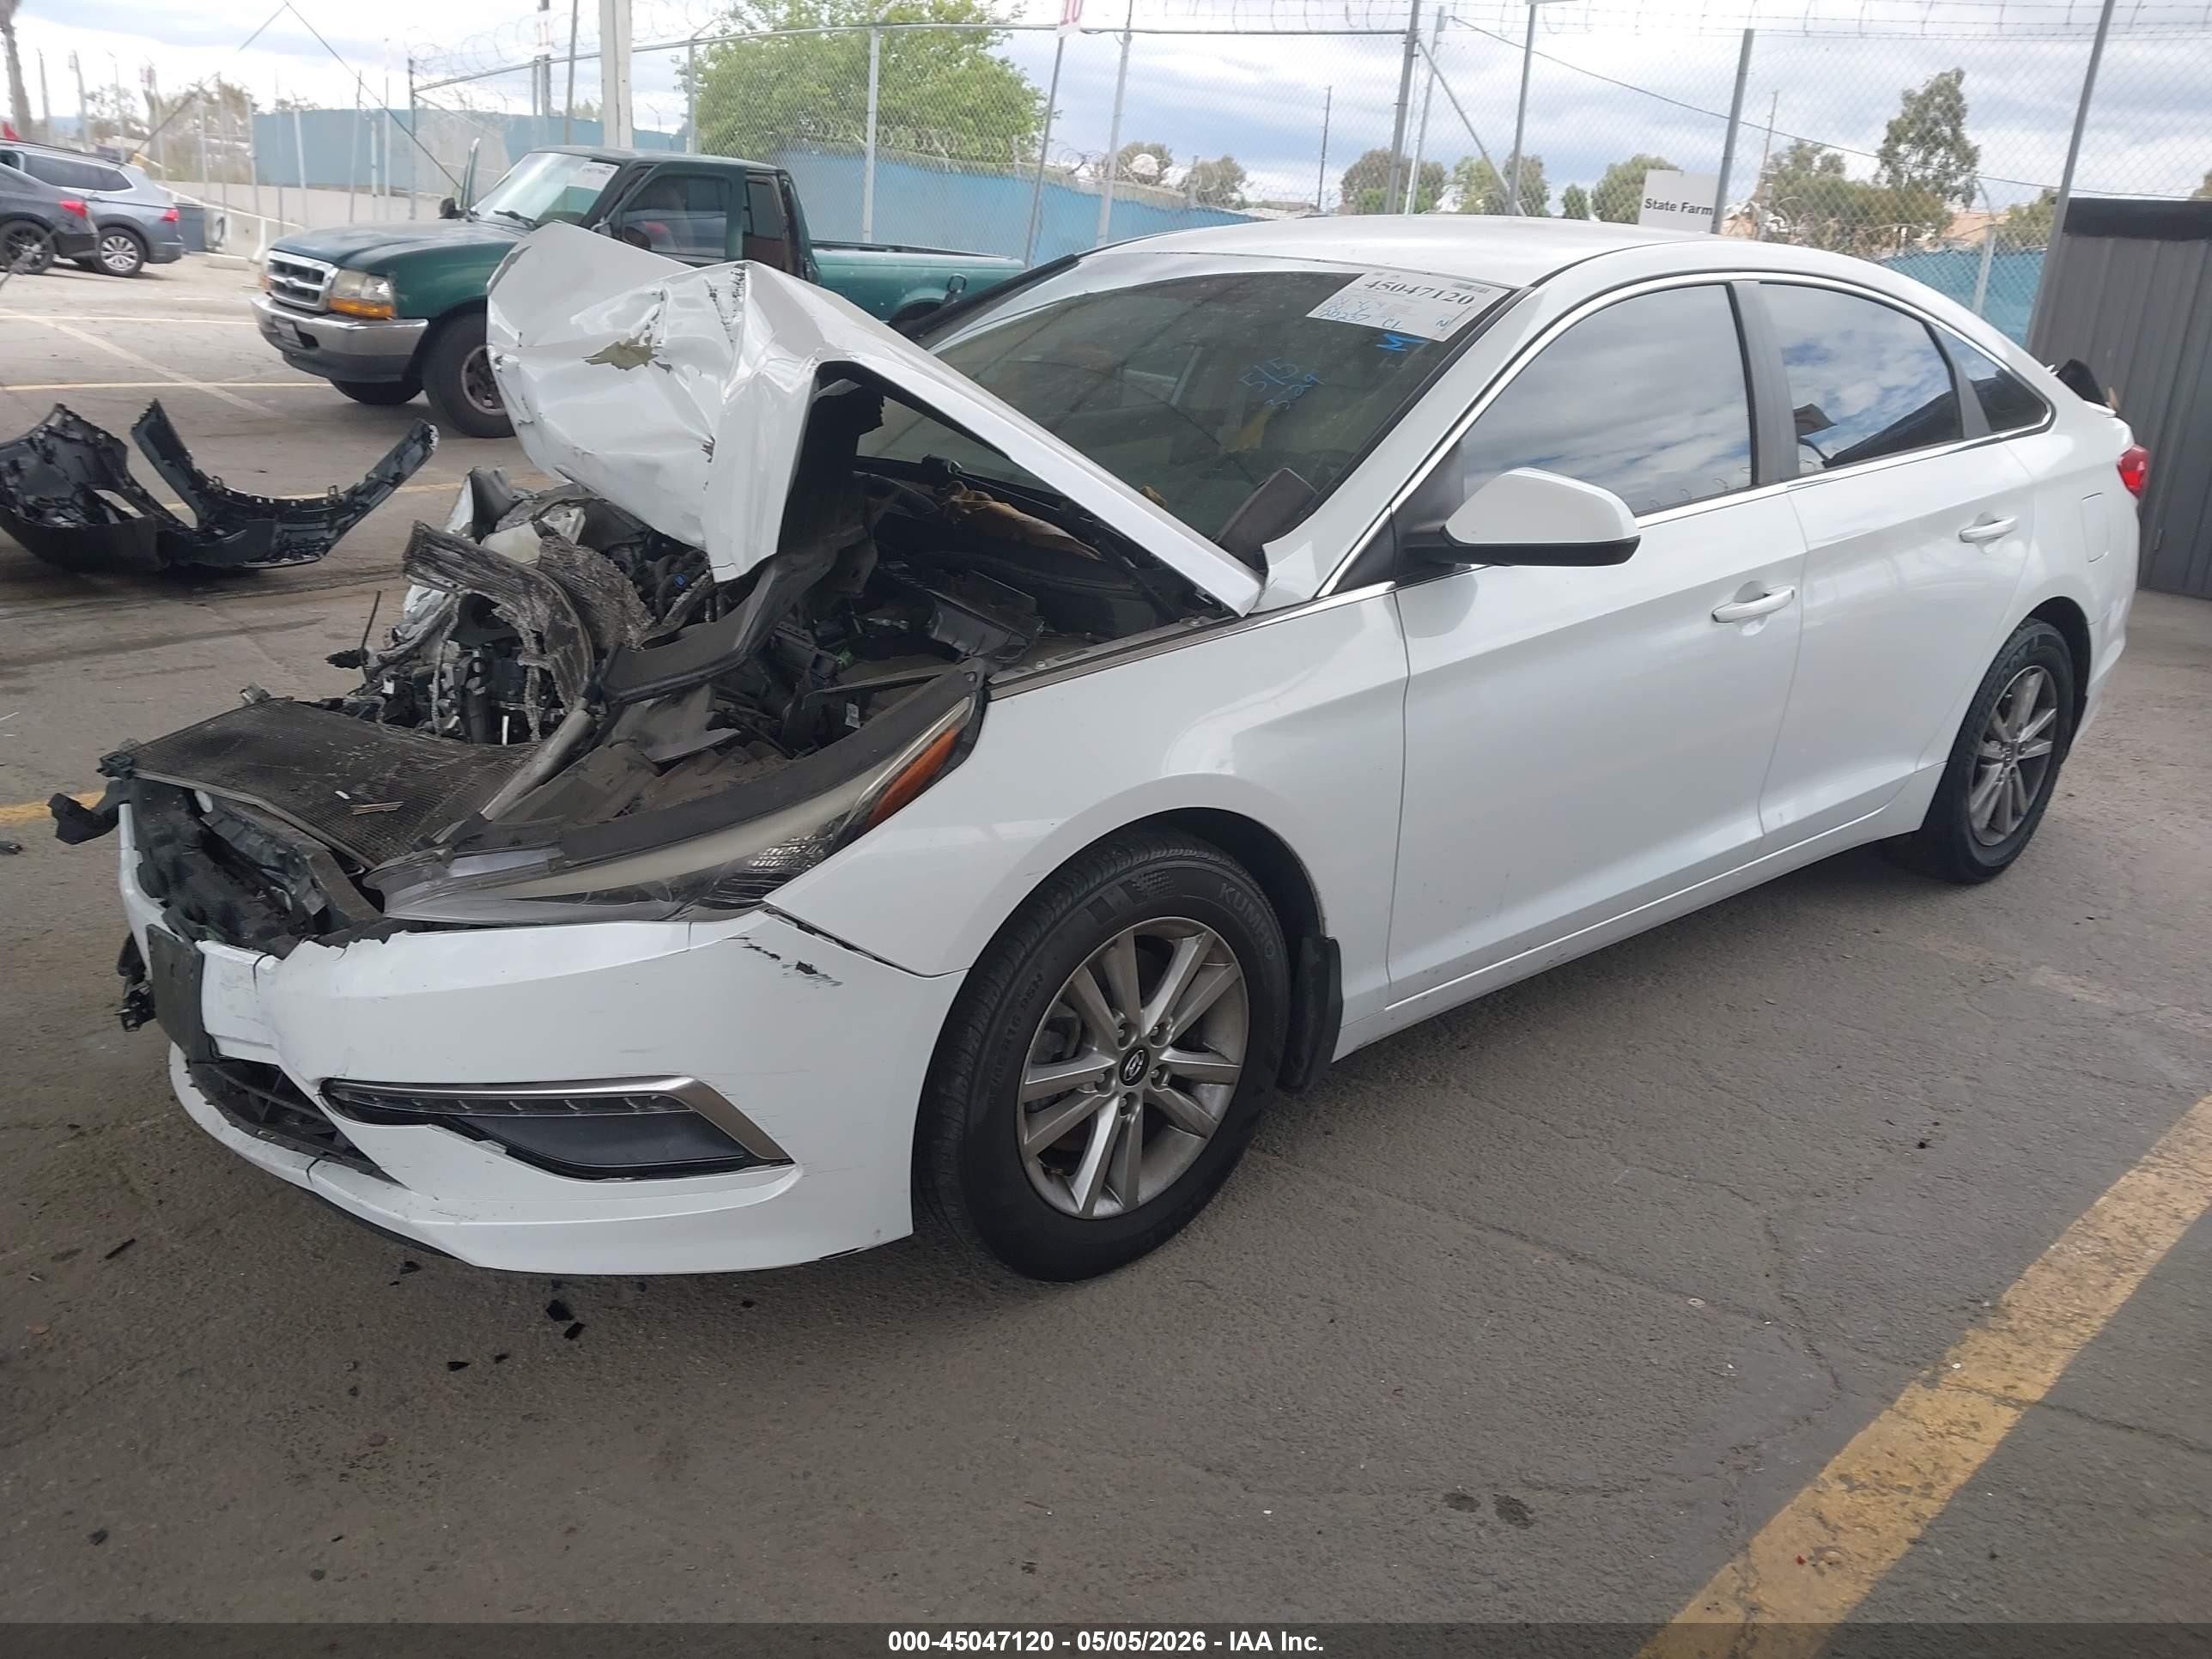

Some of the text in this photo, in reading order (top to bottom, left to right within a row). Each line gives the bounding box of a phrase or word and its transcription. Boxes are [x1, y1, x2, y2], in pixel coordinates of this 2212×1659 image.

[1644, 198, 1713, 215] State Farm
[1364, 279, 1475, 305] 45047120
[1218, 882, 1278, 961] KUMHO
